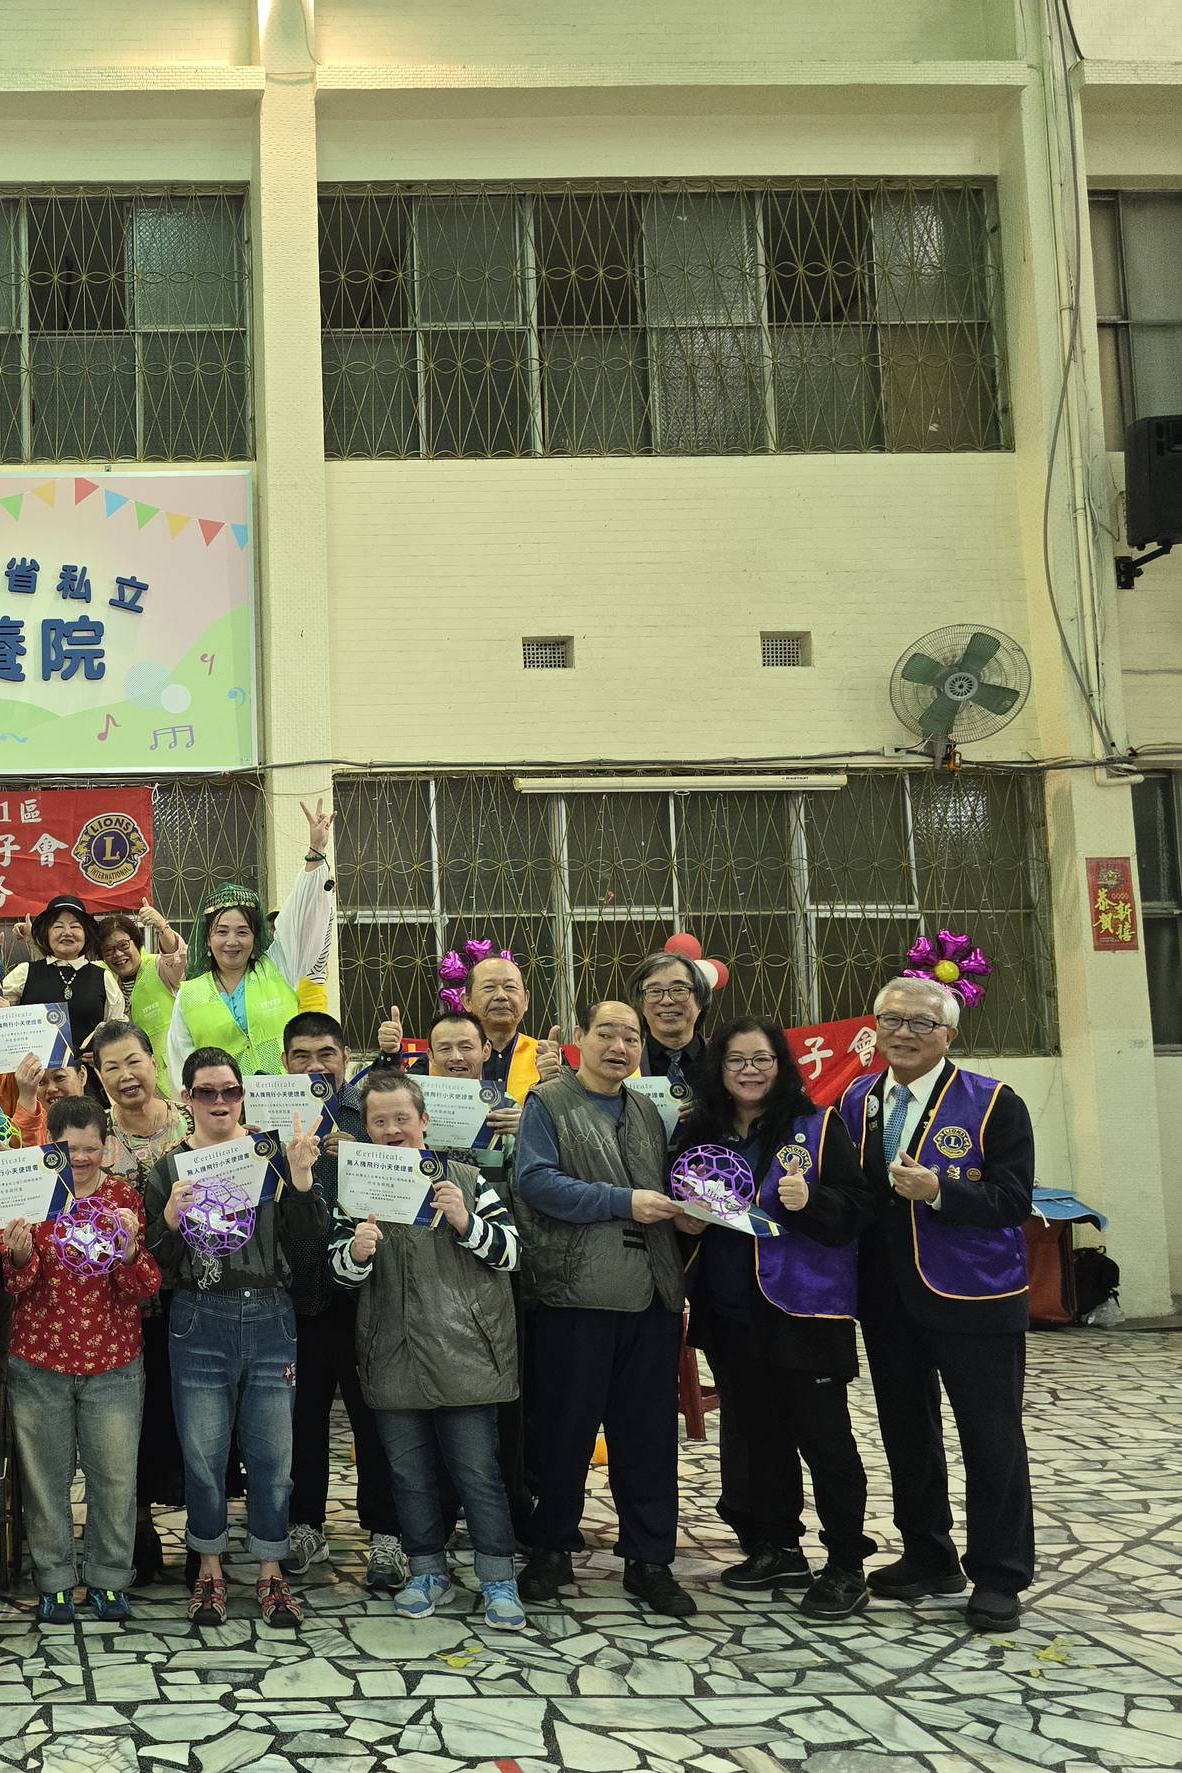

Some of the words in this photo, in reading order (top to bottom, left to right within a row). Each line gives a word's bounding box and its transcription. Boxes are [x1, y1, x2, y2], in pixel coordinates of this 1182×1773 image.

[89, 816, 132, 833] LIONS
[103, 836, 121, 861] L
[90, 865, 132, 882] INTERNATIONAL
